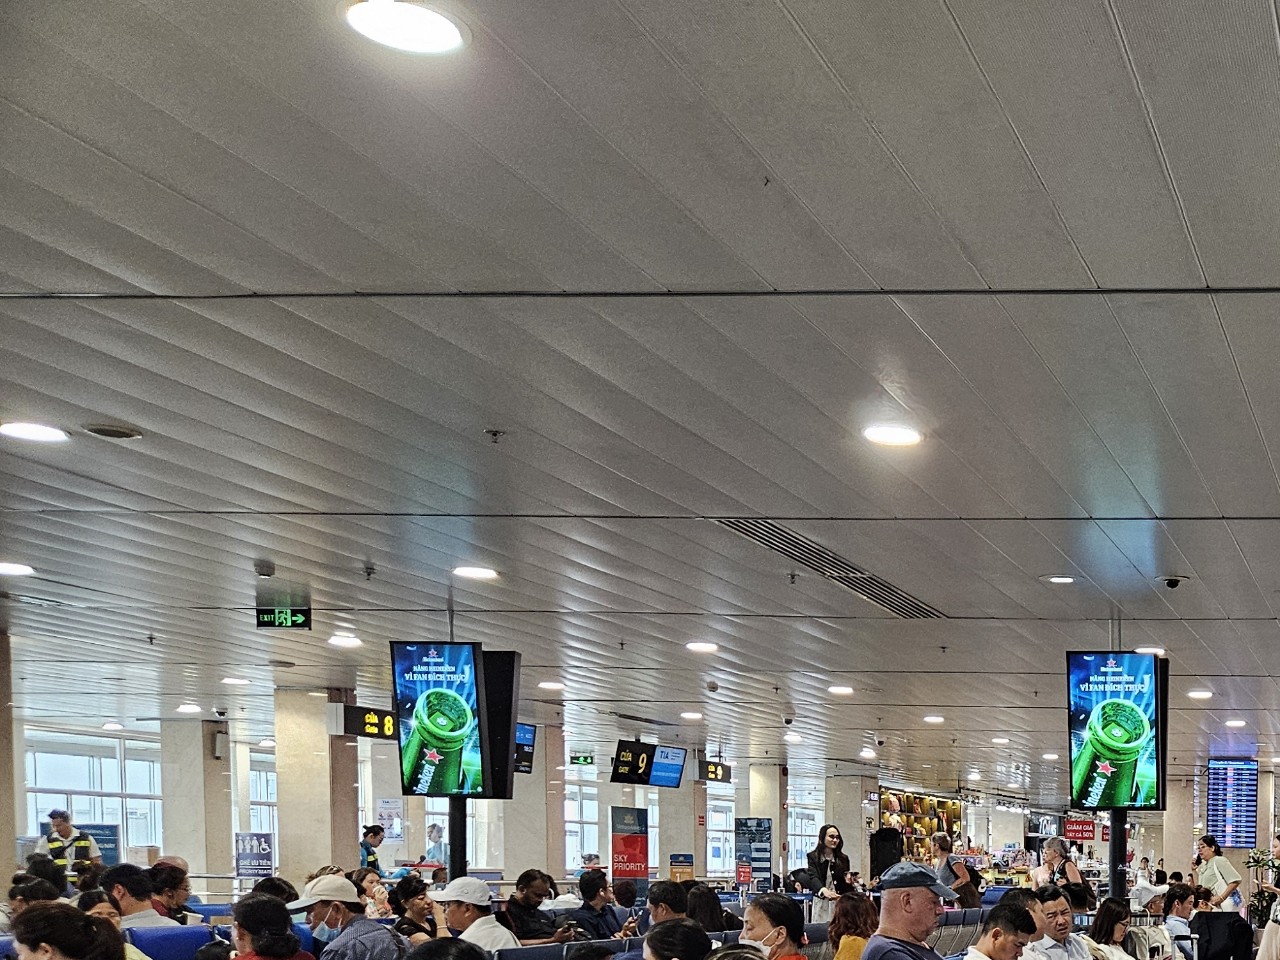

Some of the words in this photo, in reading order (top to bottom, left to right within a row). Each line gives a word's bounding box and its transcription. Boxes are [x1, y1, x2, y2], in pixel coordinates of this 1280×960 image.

[413, 673, 427, 681] FAN
[383, 715, 394, 736] 8
[638, 753, 647, 774] 9
[1066, 823, 1082, 831] GIẢM
[1083, 823, 1094, 831] GIÁ
[614, 854, 628, 862] SKY
[613, 862, 646, 871] PRIORITY
